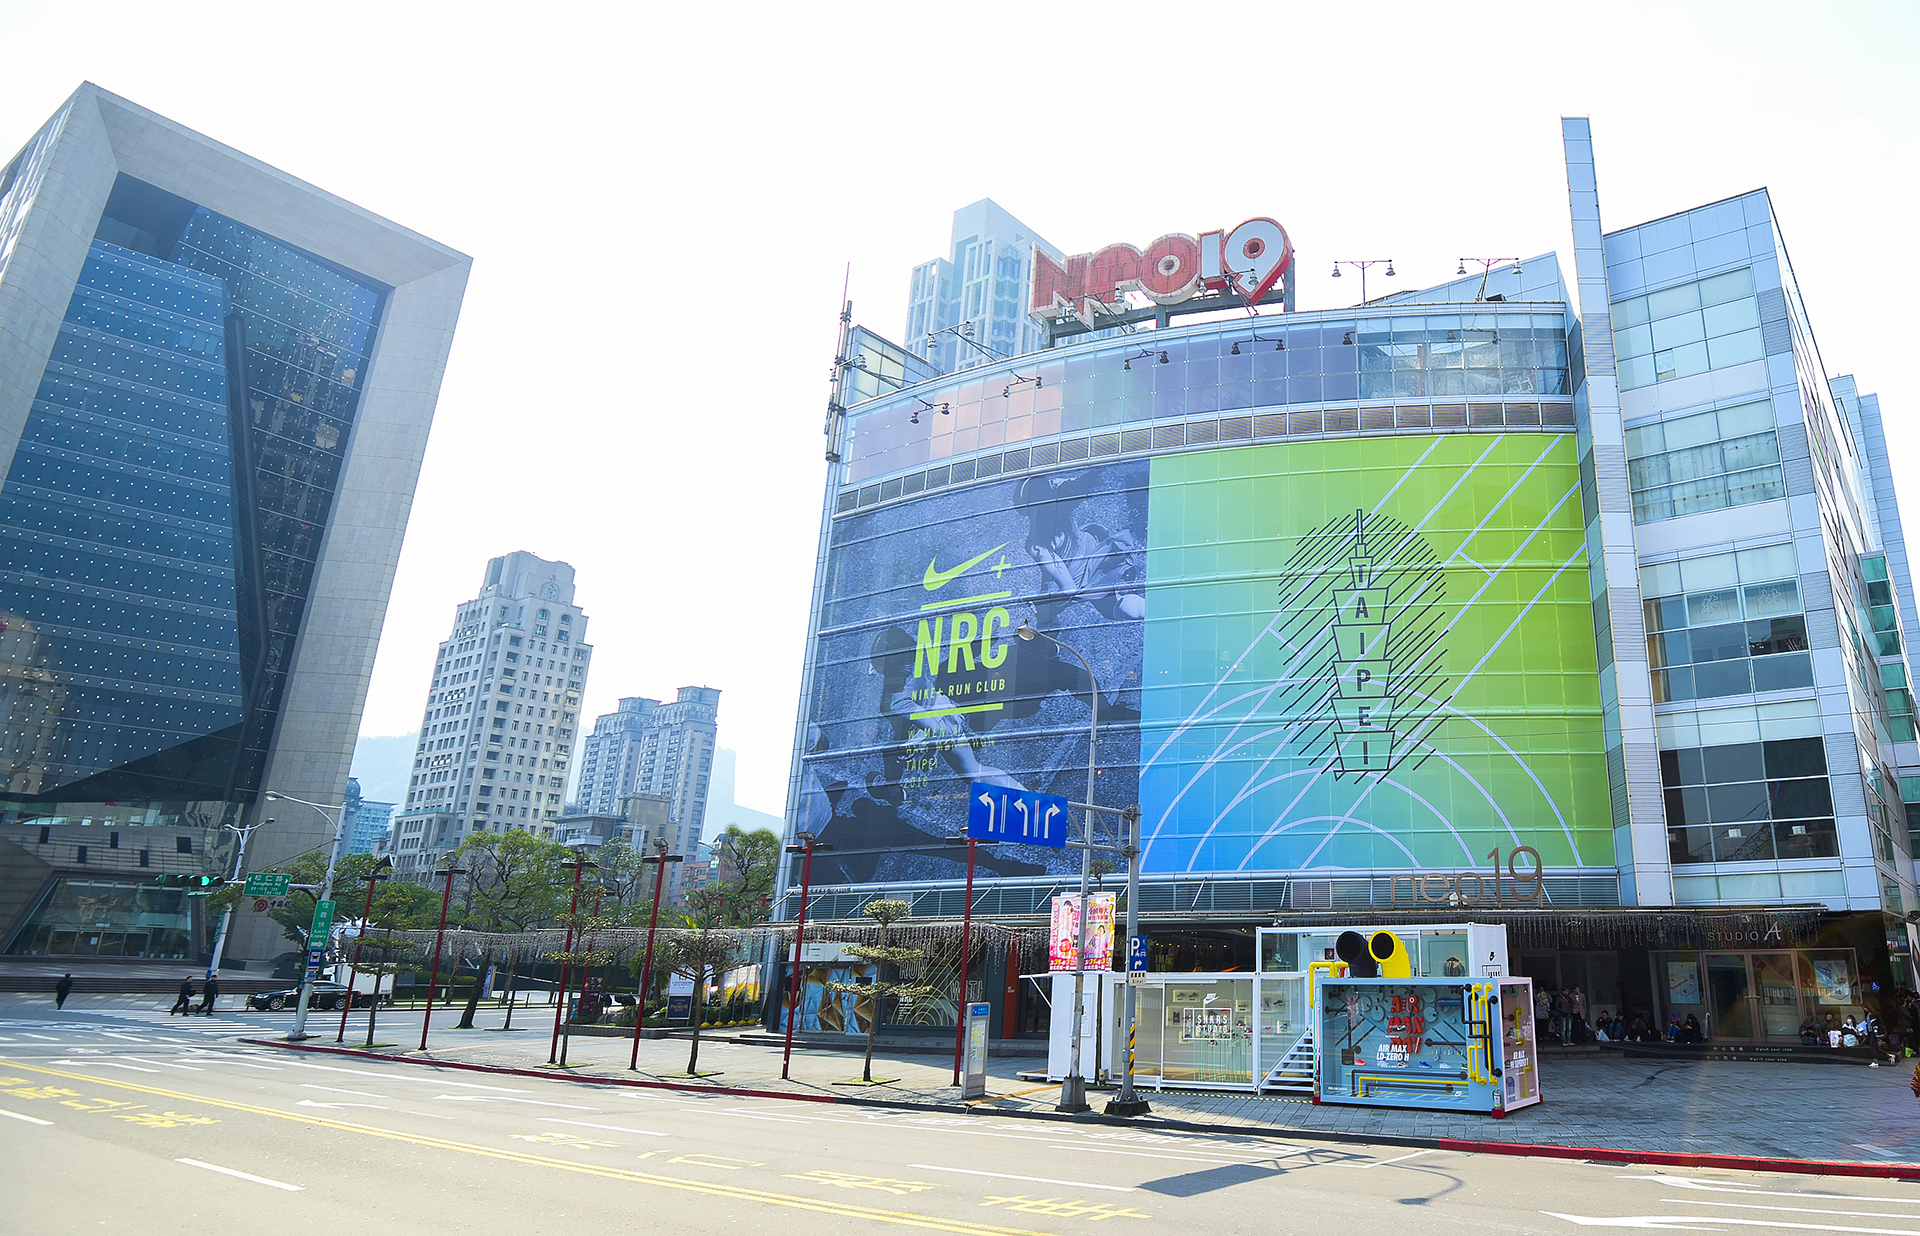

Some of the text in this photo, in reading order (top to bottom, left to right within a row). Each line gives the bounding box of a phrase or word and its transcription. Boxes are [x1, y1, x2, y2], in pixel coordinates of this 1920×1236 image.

[914, 607, 1010, 678] NRC
[1355, 563, 1371, 765] TAIPEI
[911, 678, 1006, 701] NIKE+ RUN CLUB
[906, 758, 938, 771] TAIPEI
[903, 776, 929, 789] 2016
[1390, 846, 1542, 903] neo19
[1707, 921, 1782, 941] STUDIO A
[1131, 937, 1140, 956] P
[899, 959, 928, 979] RUN
[1197, 1014, 1228, 1025] SNKRS
[1197, 1025, 1228, 1033] STUDIO
[1376, 1052, 1410, 1061] LD-ZERO H
[1378, 1044, 1408, 1053] AIR MAX
